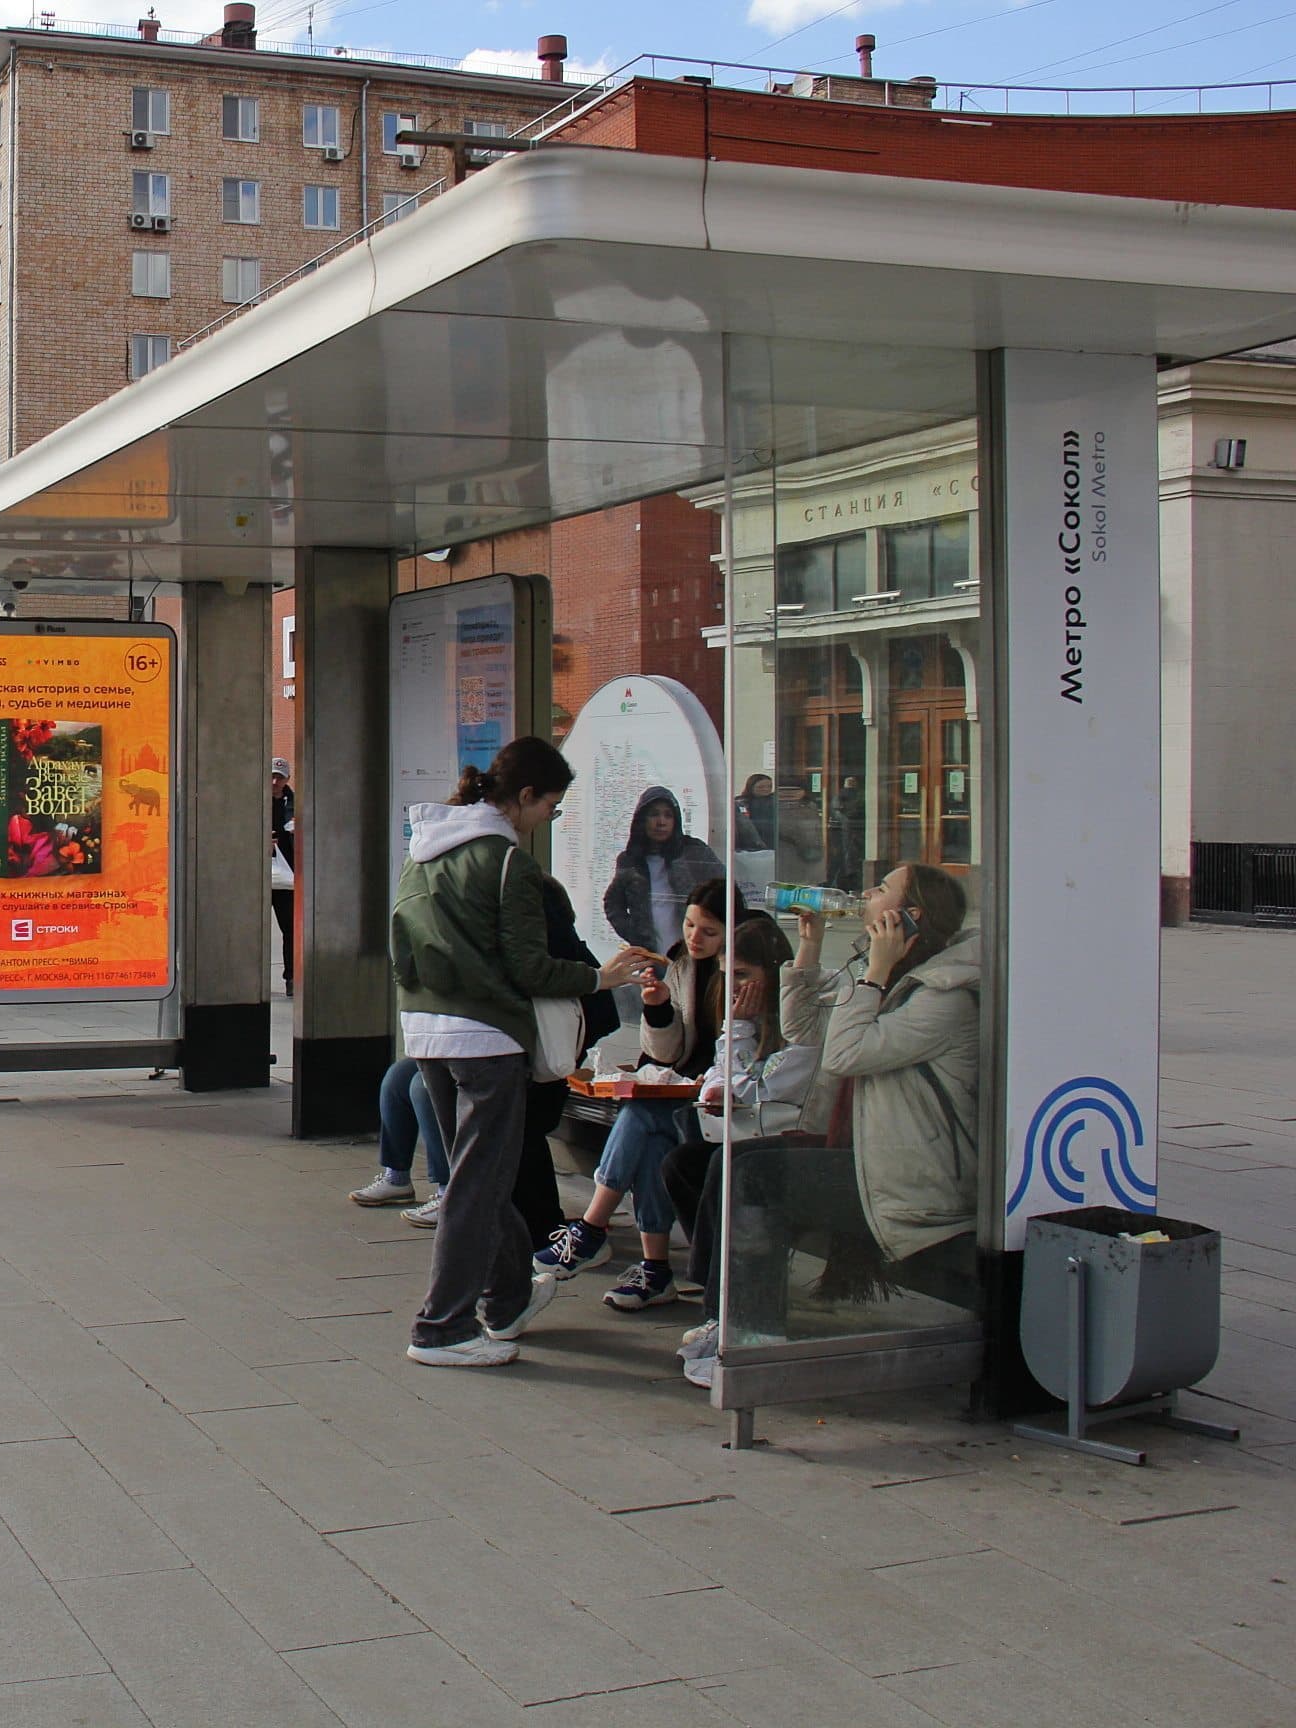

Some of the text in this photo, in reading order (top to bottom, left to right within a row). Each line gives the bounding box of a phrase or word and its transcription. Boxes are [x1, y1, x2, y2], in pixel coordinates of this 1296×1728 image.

[1091, 431, 1107, 562] Sokol Metro
[804, 491, 903, 523] СТАНЦИЯ
[1058, 430, 1087, 704] Метро «Сокол»
[128, 655, 158, 671] 16+
[28, 685, 80, 696] история
[83, 686, 91, 694] о
[93, 686, 135, 696] семье,
[8, 698, 52, 710] судьбе
[67, 701, 131, 709] медицине
[27, 755, 85, 772] Абрахам
[25, 776, 90, 801] Завет
[9, 890, 64, 899] книжных
[66, 890, 127, 899] магазинах
[103, 901, 138, 910] Строки
[36, 925, 79, 934] СТРОКИ
[73, 972, 94, 981] ОГРН
